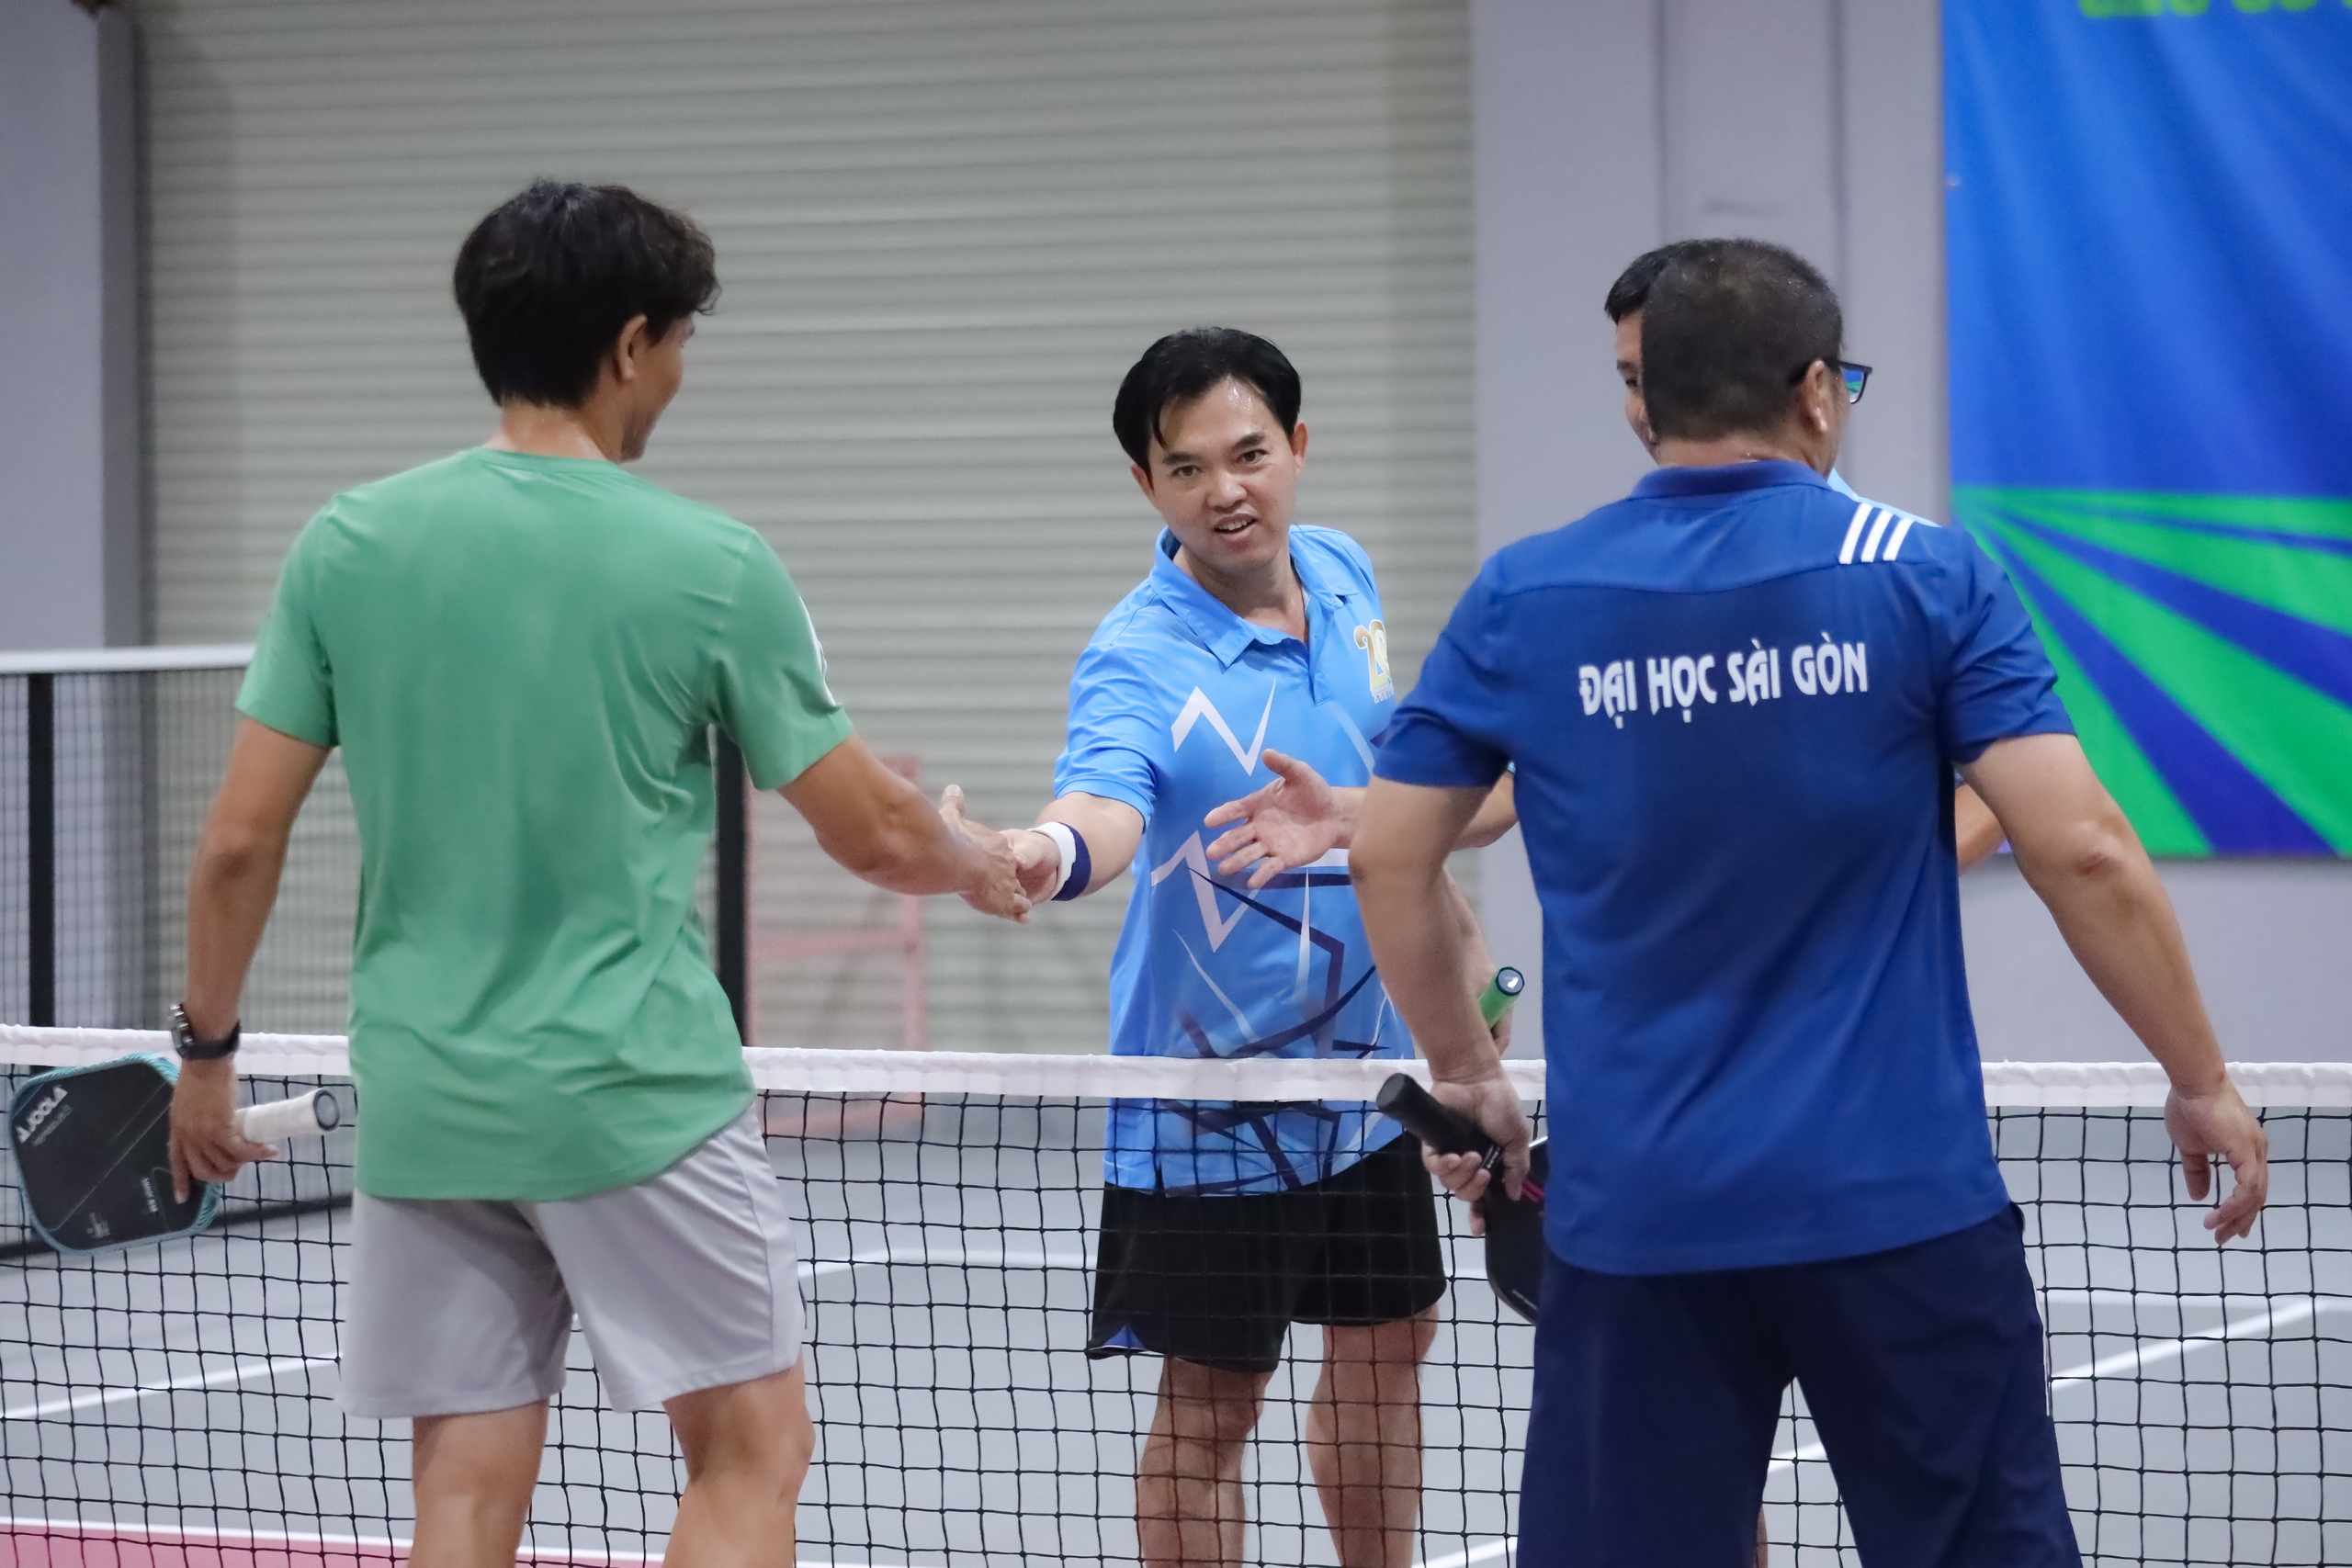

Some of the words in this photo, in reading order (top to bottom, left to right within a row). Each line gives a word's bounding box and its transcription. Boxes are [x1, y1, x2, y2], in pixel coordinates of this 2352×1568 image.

[1578, 660, 1638, 729] ĐẠI
[1646, 655, 1718, 724] HỌC
[1726, 637, 1781, 707] SÀI
[1791, 631, 1869, 696] GÒN
[26, 1085, 69, 1133] JOOLA
